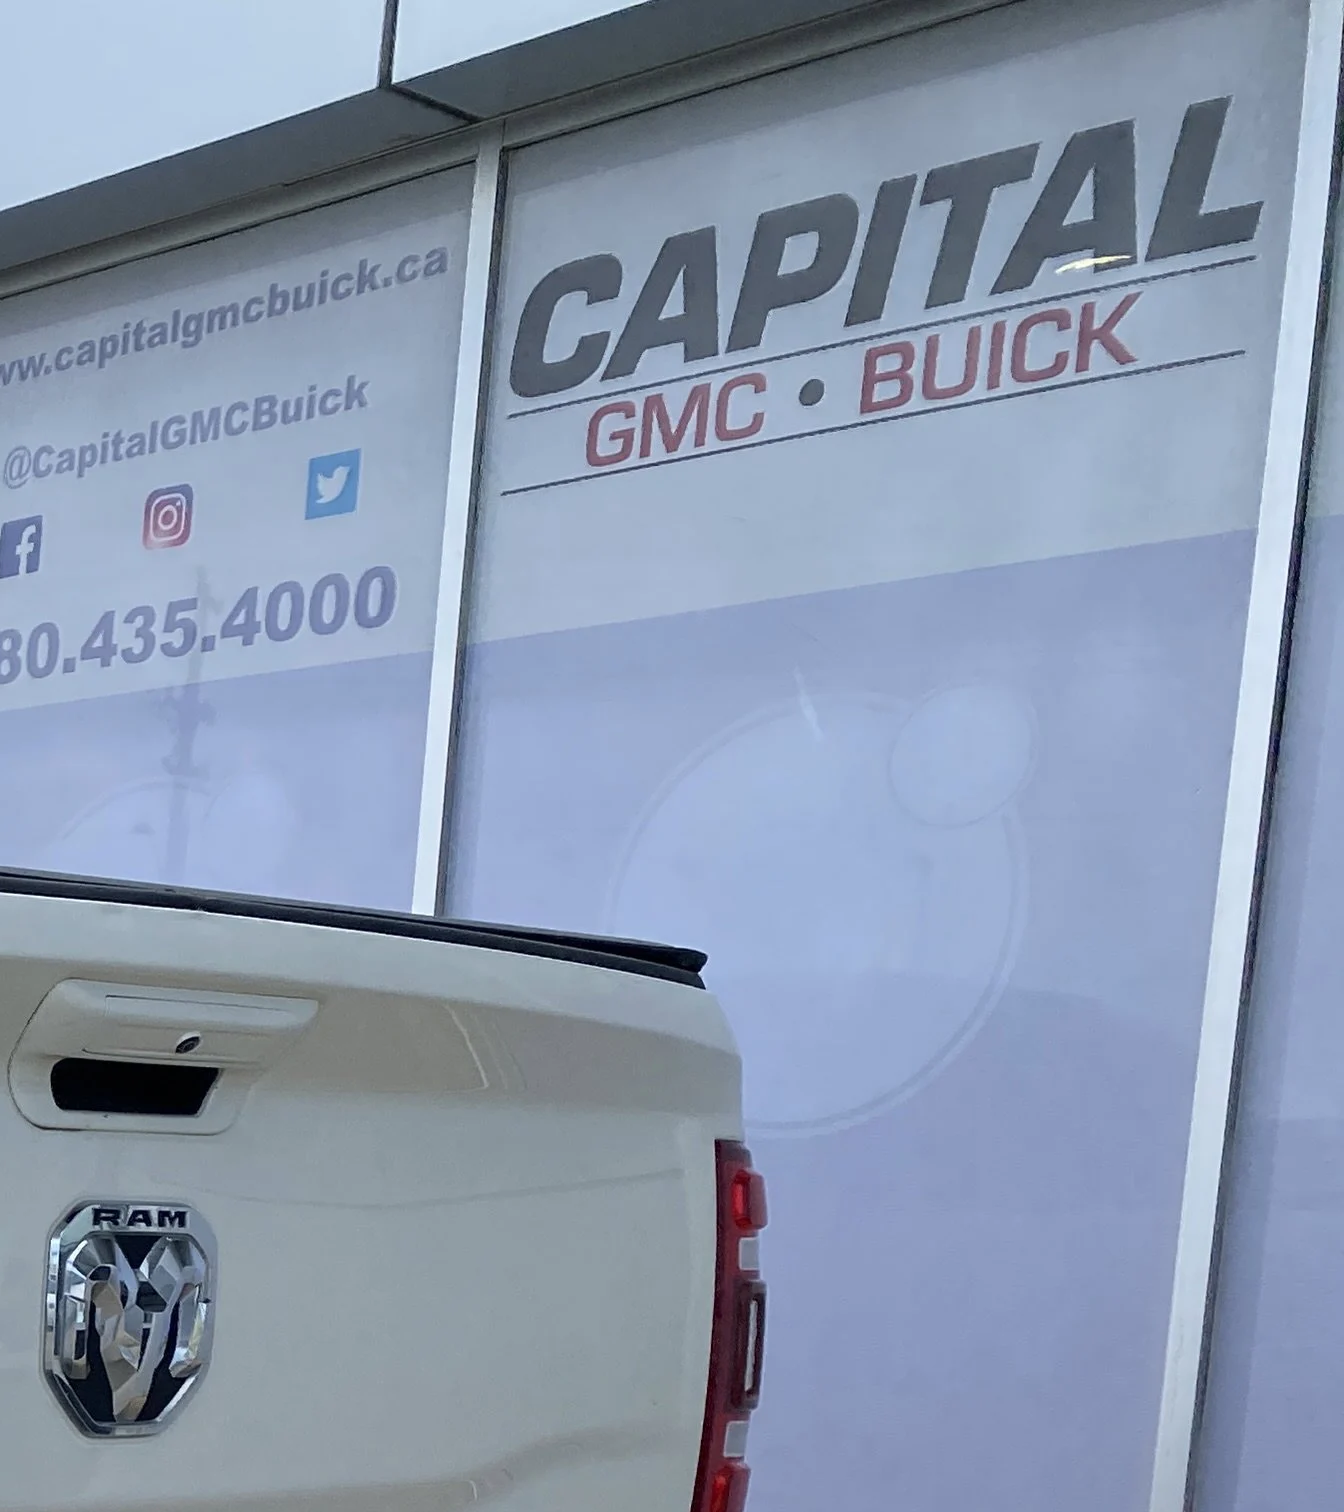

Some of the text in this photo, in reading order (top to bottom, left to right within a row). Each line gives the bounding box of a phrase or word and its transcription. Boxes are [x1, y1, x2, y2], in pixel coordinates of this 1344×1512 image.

[510, 96, 1264, 398] CAPITAL
[3, 375, 370, 489] @CapitalGMCBuick
[586, 293, 1141, 467] GMC BUICK
[92, 1208, 188, 1229] RAM
